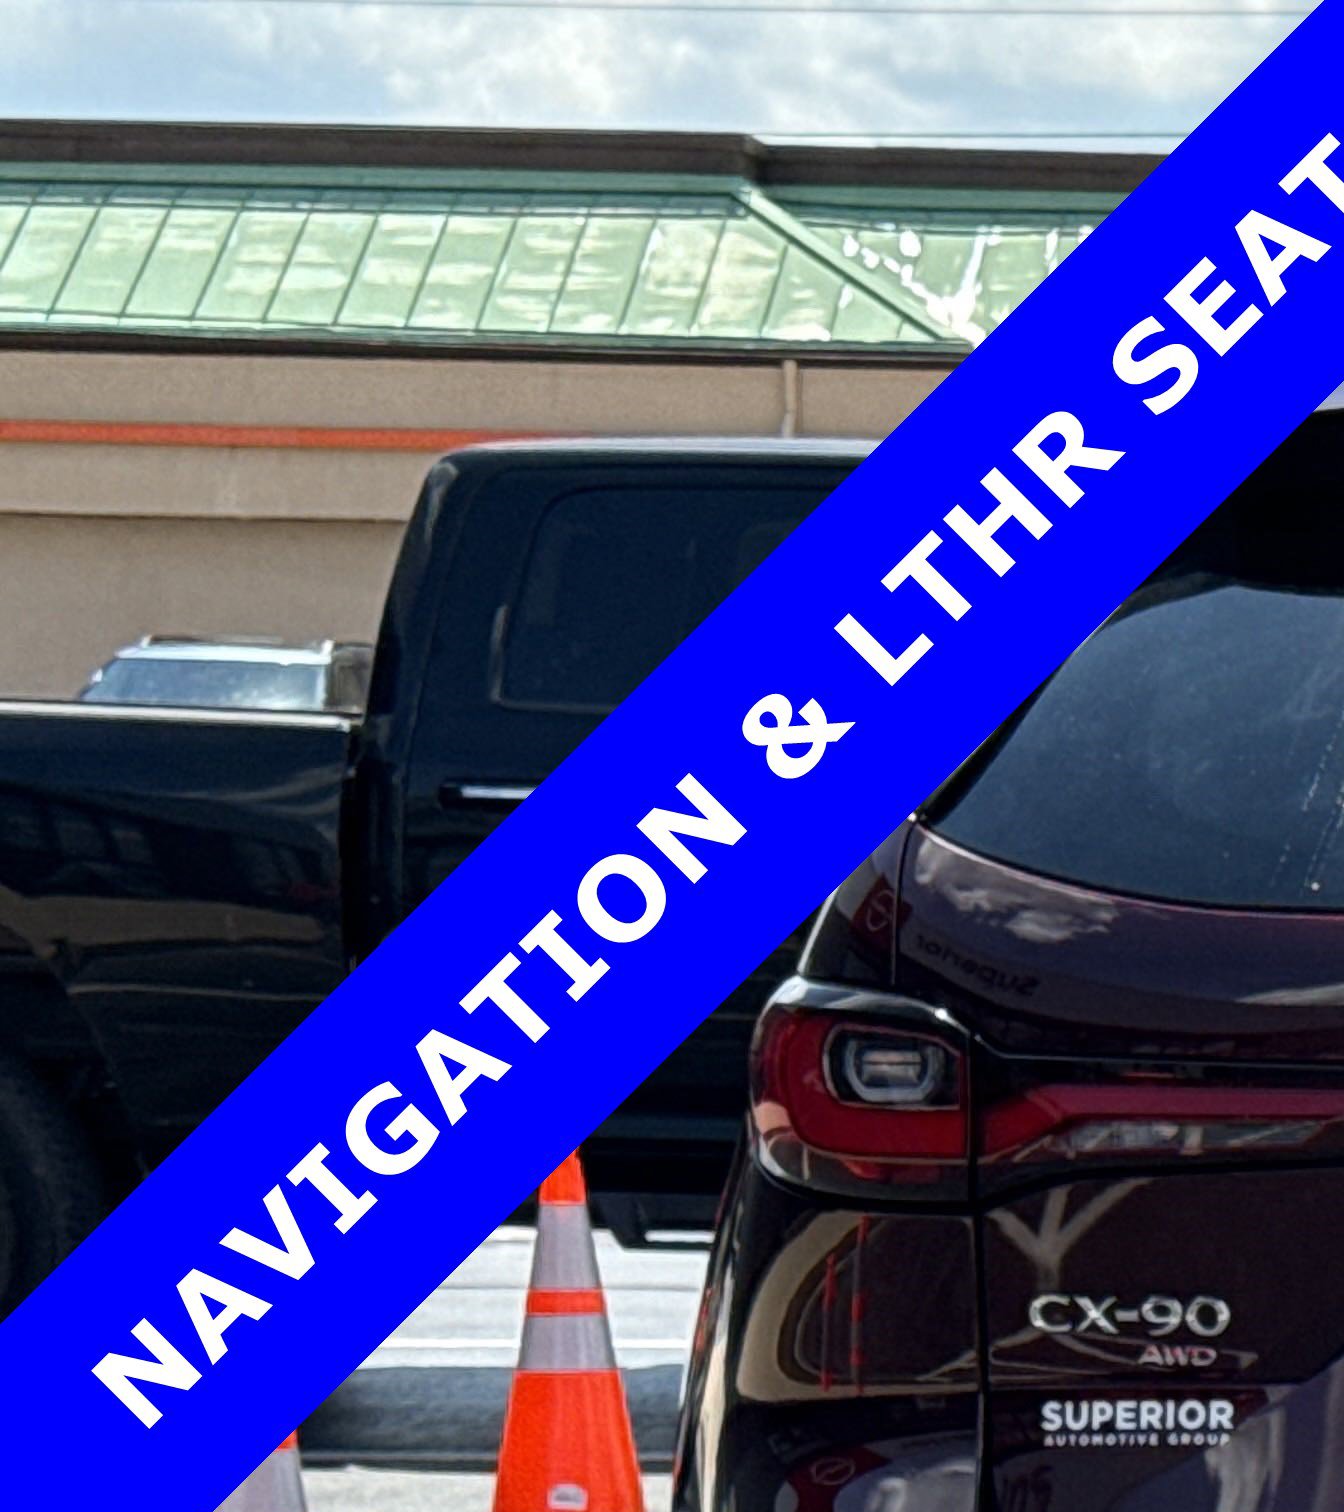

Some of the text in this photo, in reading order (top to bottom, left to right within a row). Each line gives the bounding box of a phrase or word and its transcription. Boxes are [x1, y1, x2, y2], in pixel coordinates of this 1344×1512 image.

[1029, 1294, 1231, 1337] CX-90
[1138, 1344, 1217, 1367] AWD
[1041, 1399, 1235, 1431] SUPERIOR
[1044, 1433, 1231, 1447] AUTOMOTIVE GROUP
